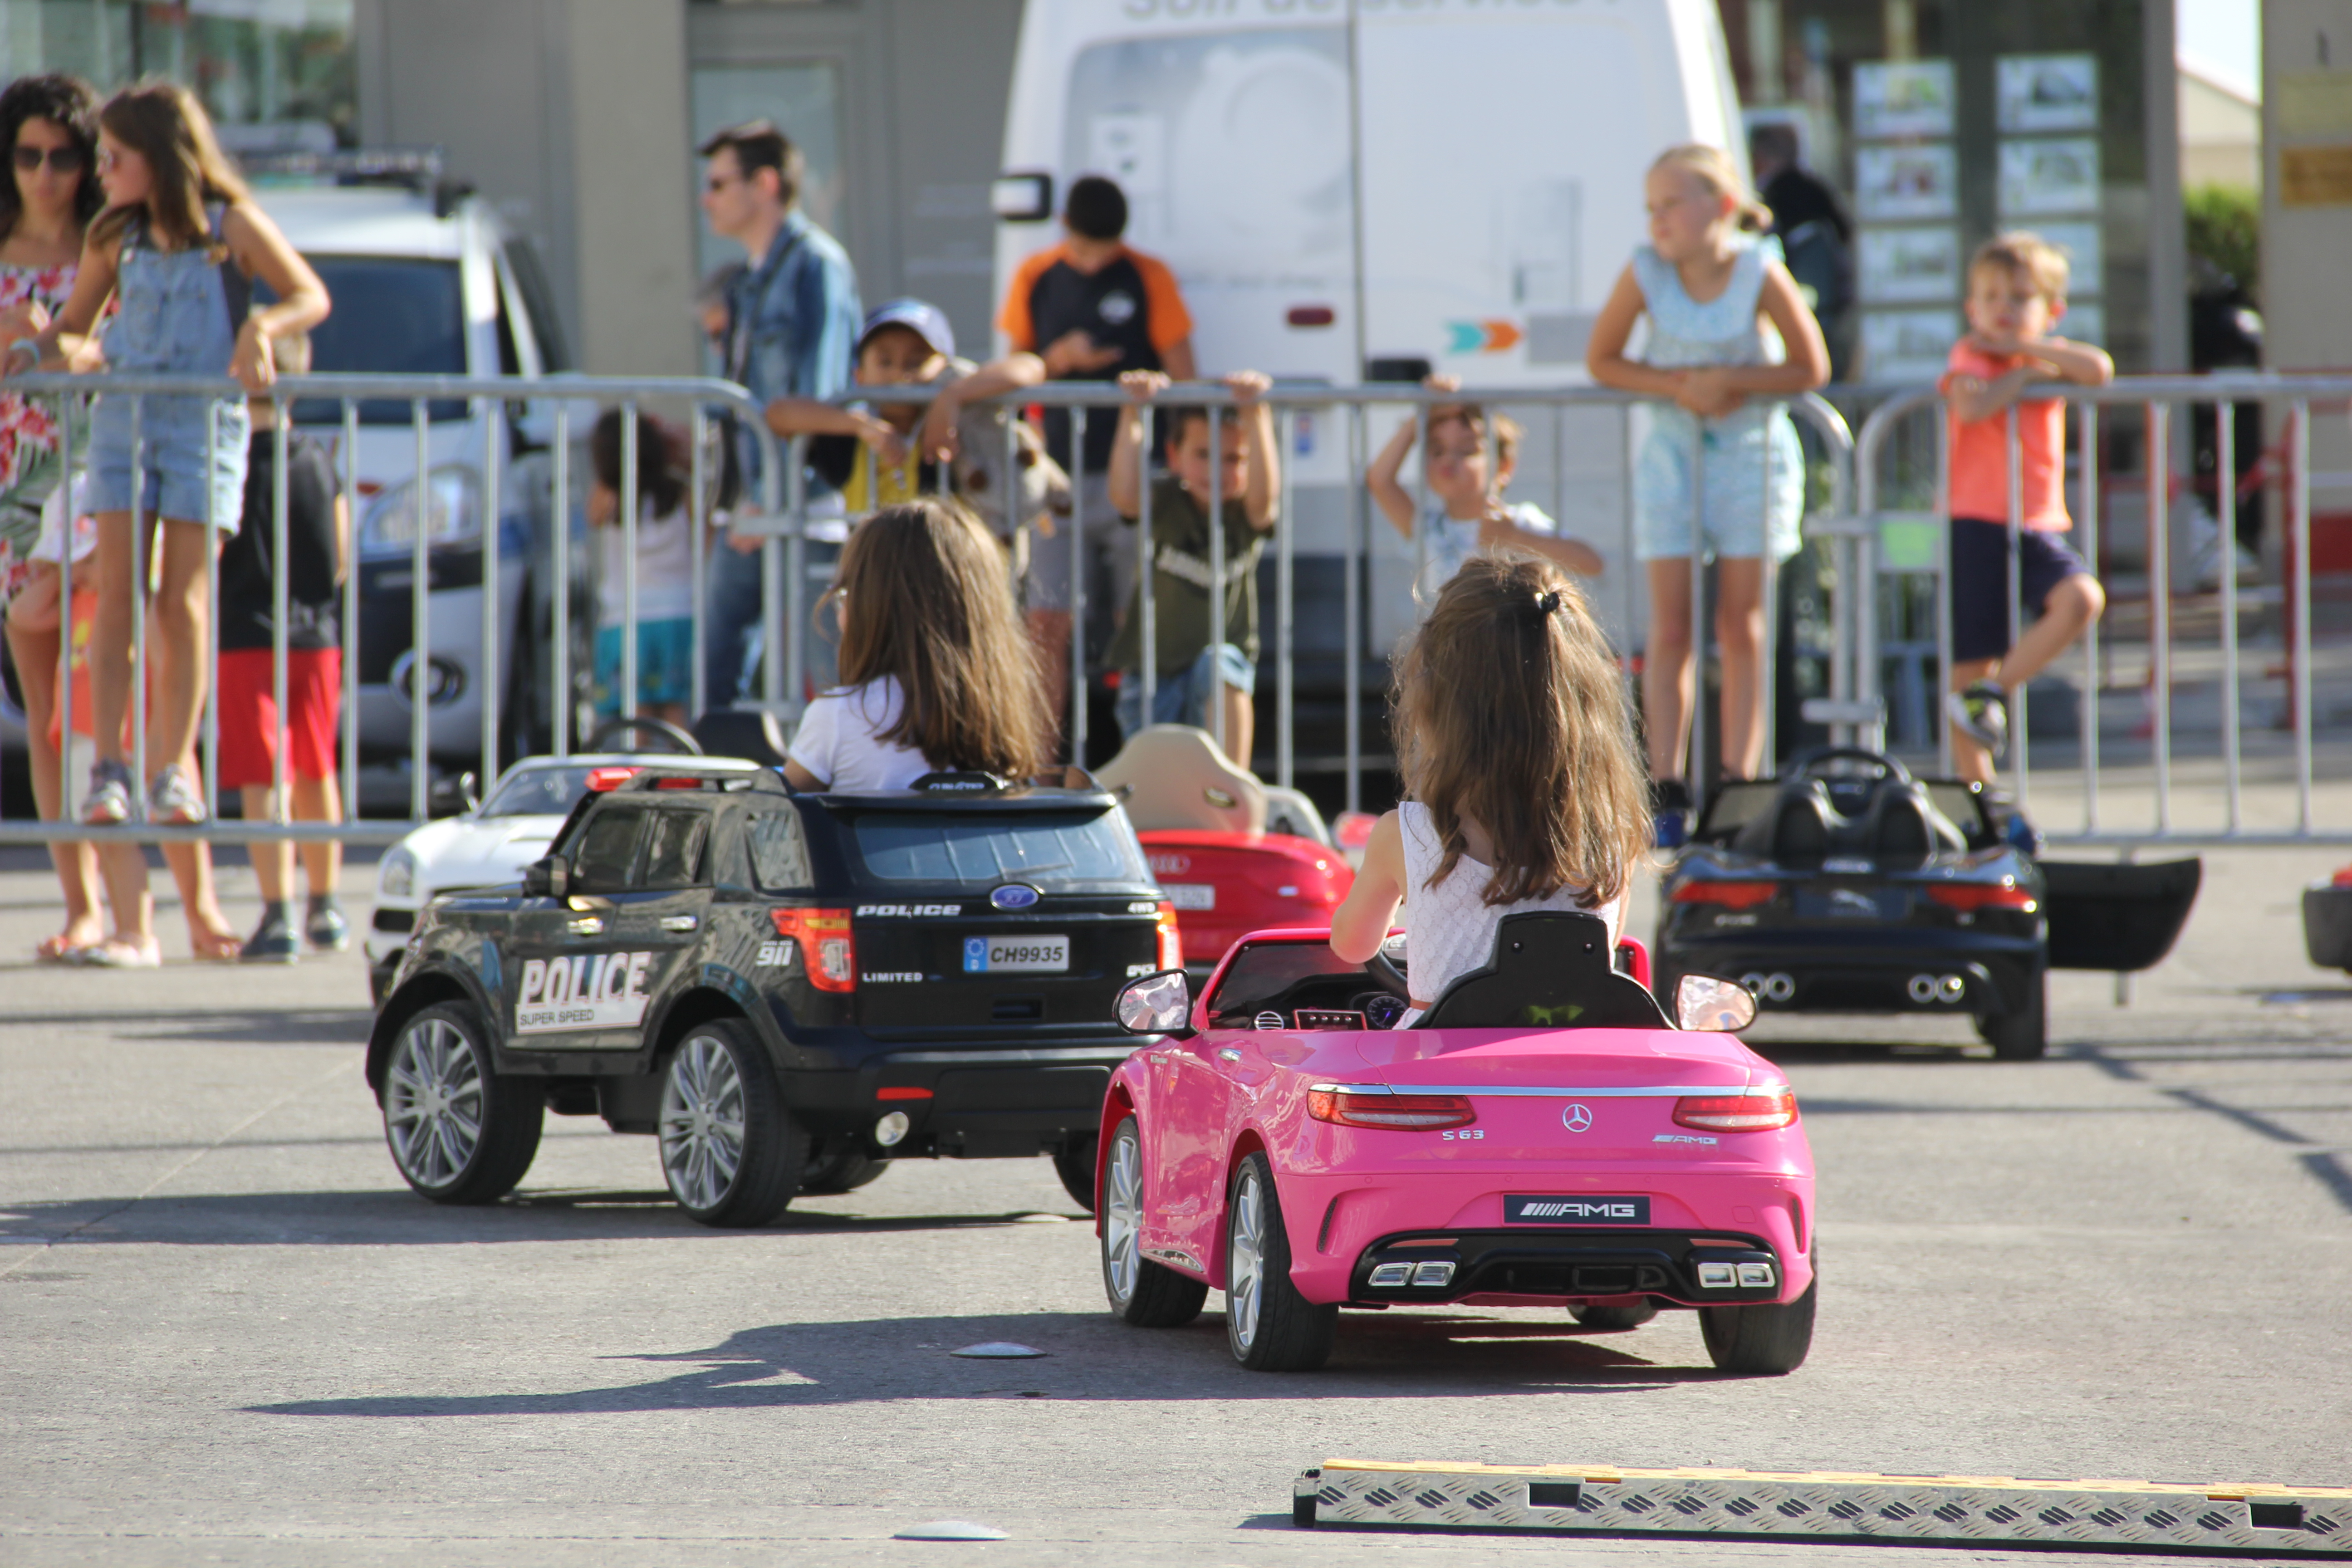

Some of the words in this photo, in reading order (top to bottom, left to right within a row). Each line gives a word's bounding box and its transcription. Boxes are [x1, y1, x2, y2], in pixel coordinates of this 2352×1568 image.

[856, 905, 961, 916] POLICE
[756, 946, 793, 966] 911
[991, 946, 1063, 962] CH9935
[519, 951, 652, 1008] POLICE
[862, 972, 923, 983] LIMITED
[520, 1012, 556, 1026] SUPER
[559, 1009, 594, 1022] SPEED
[1442, 1130, 1455, 1141] S
[1459, 1129, 1484, 1140] 63
[1556, 1203, 1635, 1217] AMG
